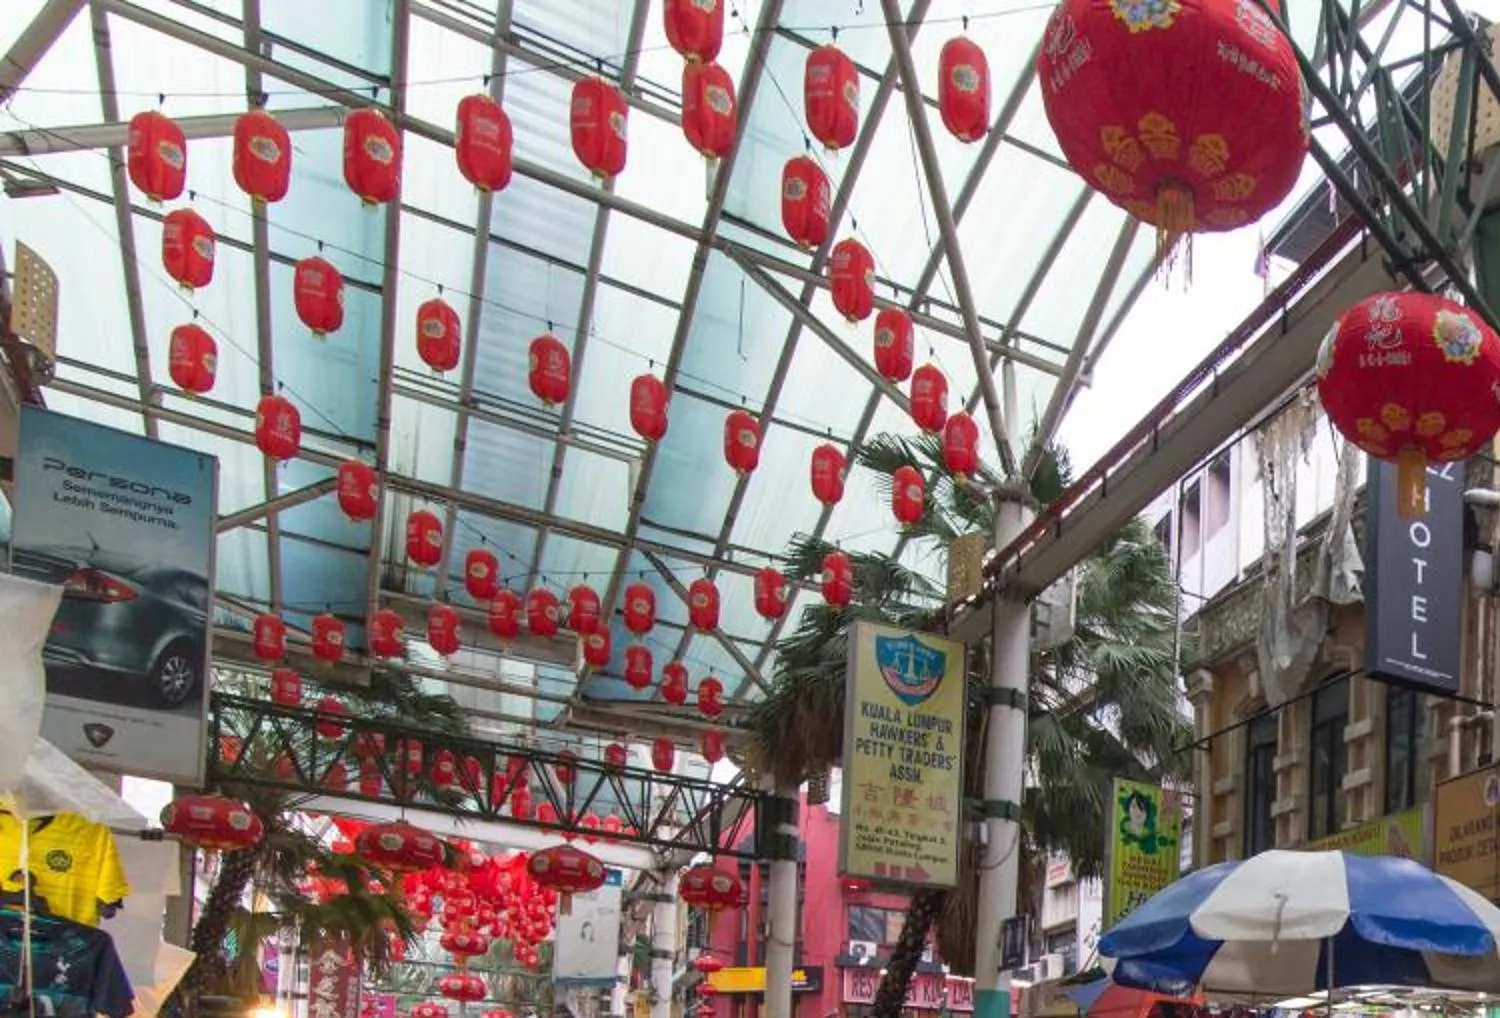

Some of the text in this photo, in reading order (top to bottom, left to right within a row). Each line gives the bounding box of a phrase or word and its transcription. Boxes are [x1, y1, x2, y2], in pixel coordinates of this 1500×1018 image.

[42, 456, 193, 505] Persona
[861, 700, 953, 735] KUALA LUMPUR
[855, 737, 895, 760] PETTY
